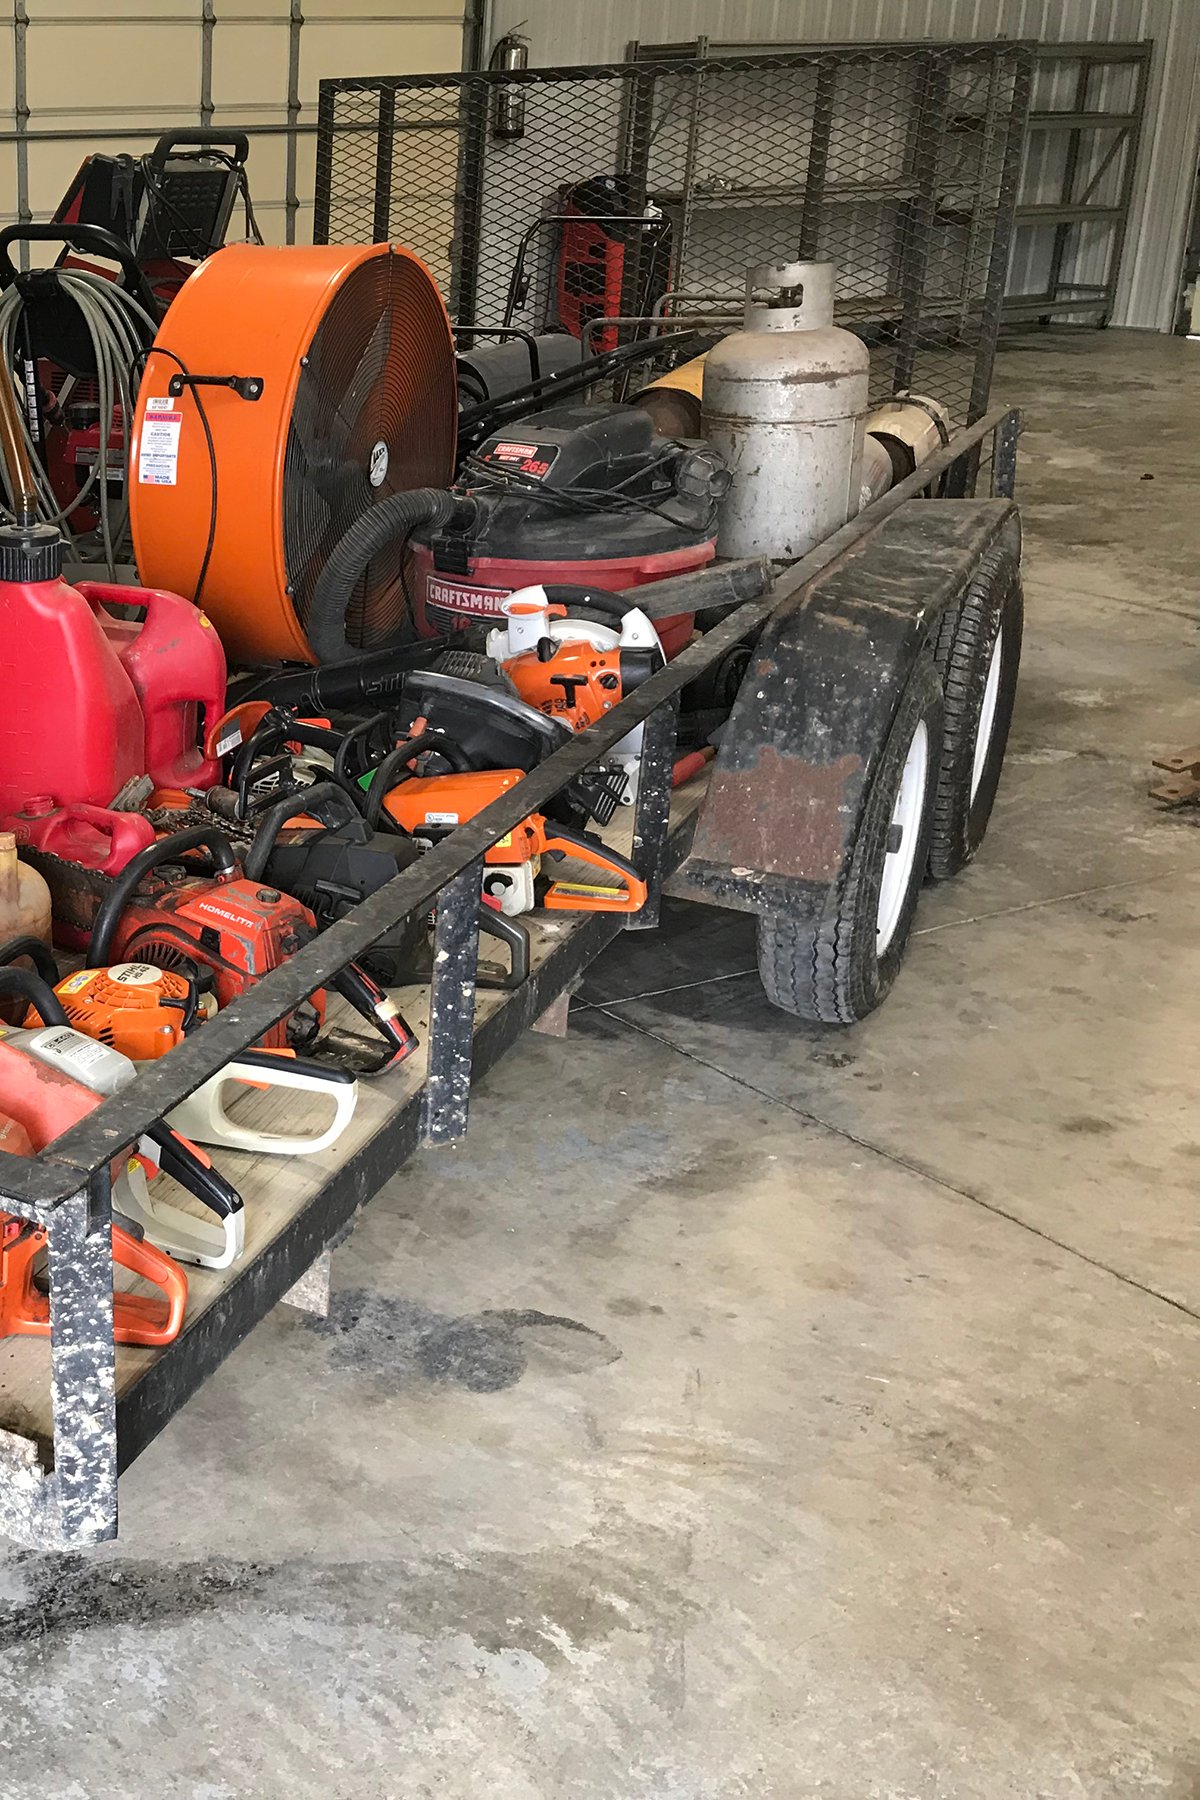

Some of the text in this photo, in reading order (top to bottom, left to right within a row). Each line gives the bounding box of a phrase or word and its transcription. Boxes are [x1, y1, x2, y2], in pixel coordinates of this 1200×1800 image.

[497, 444, 535, 456] CRAFTSMAN
[520, 458, 549, 475] 265
[429, 584, 506, 611] CRAFTSMAN
[199, 902, 254, 928] HOMELITE
[117, 965, 142, 982] STIHL
